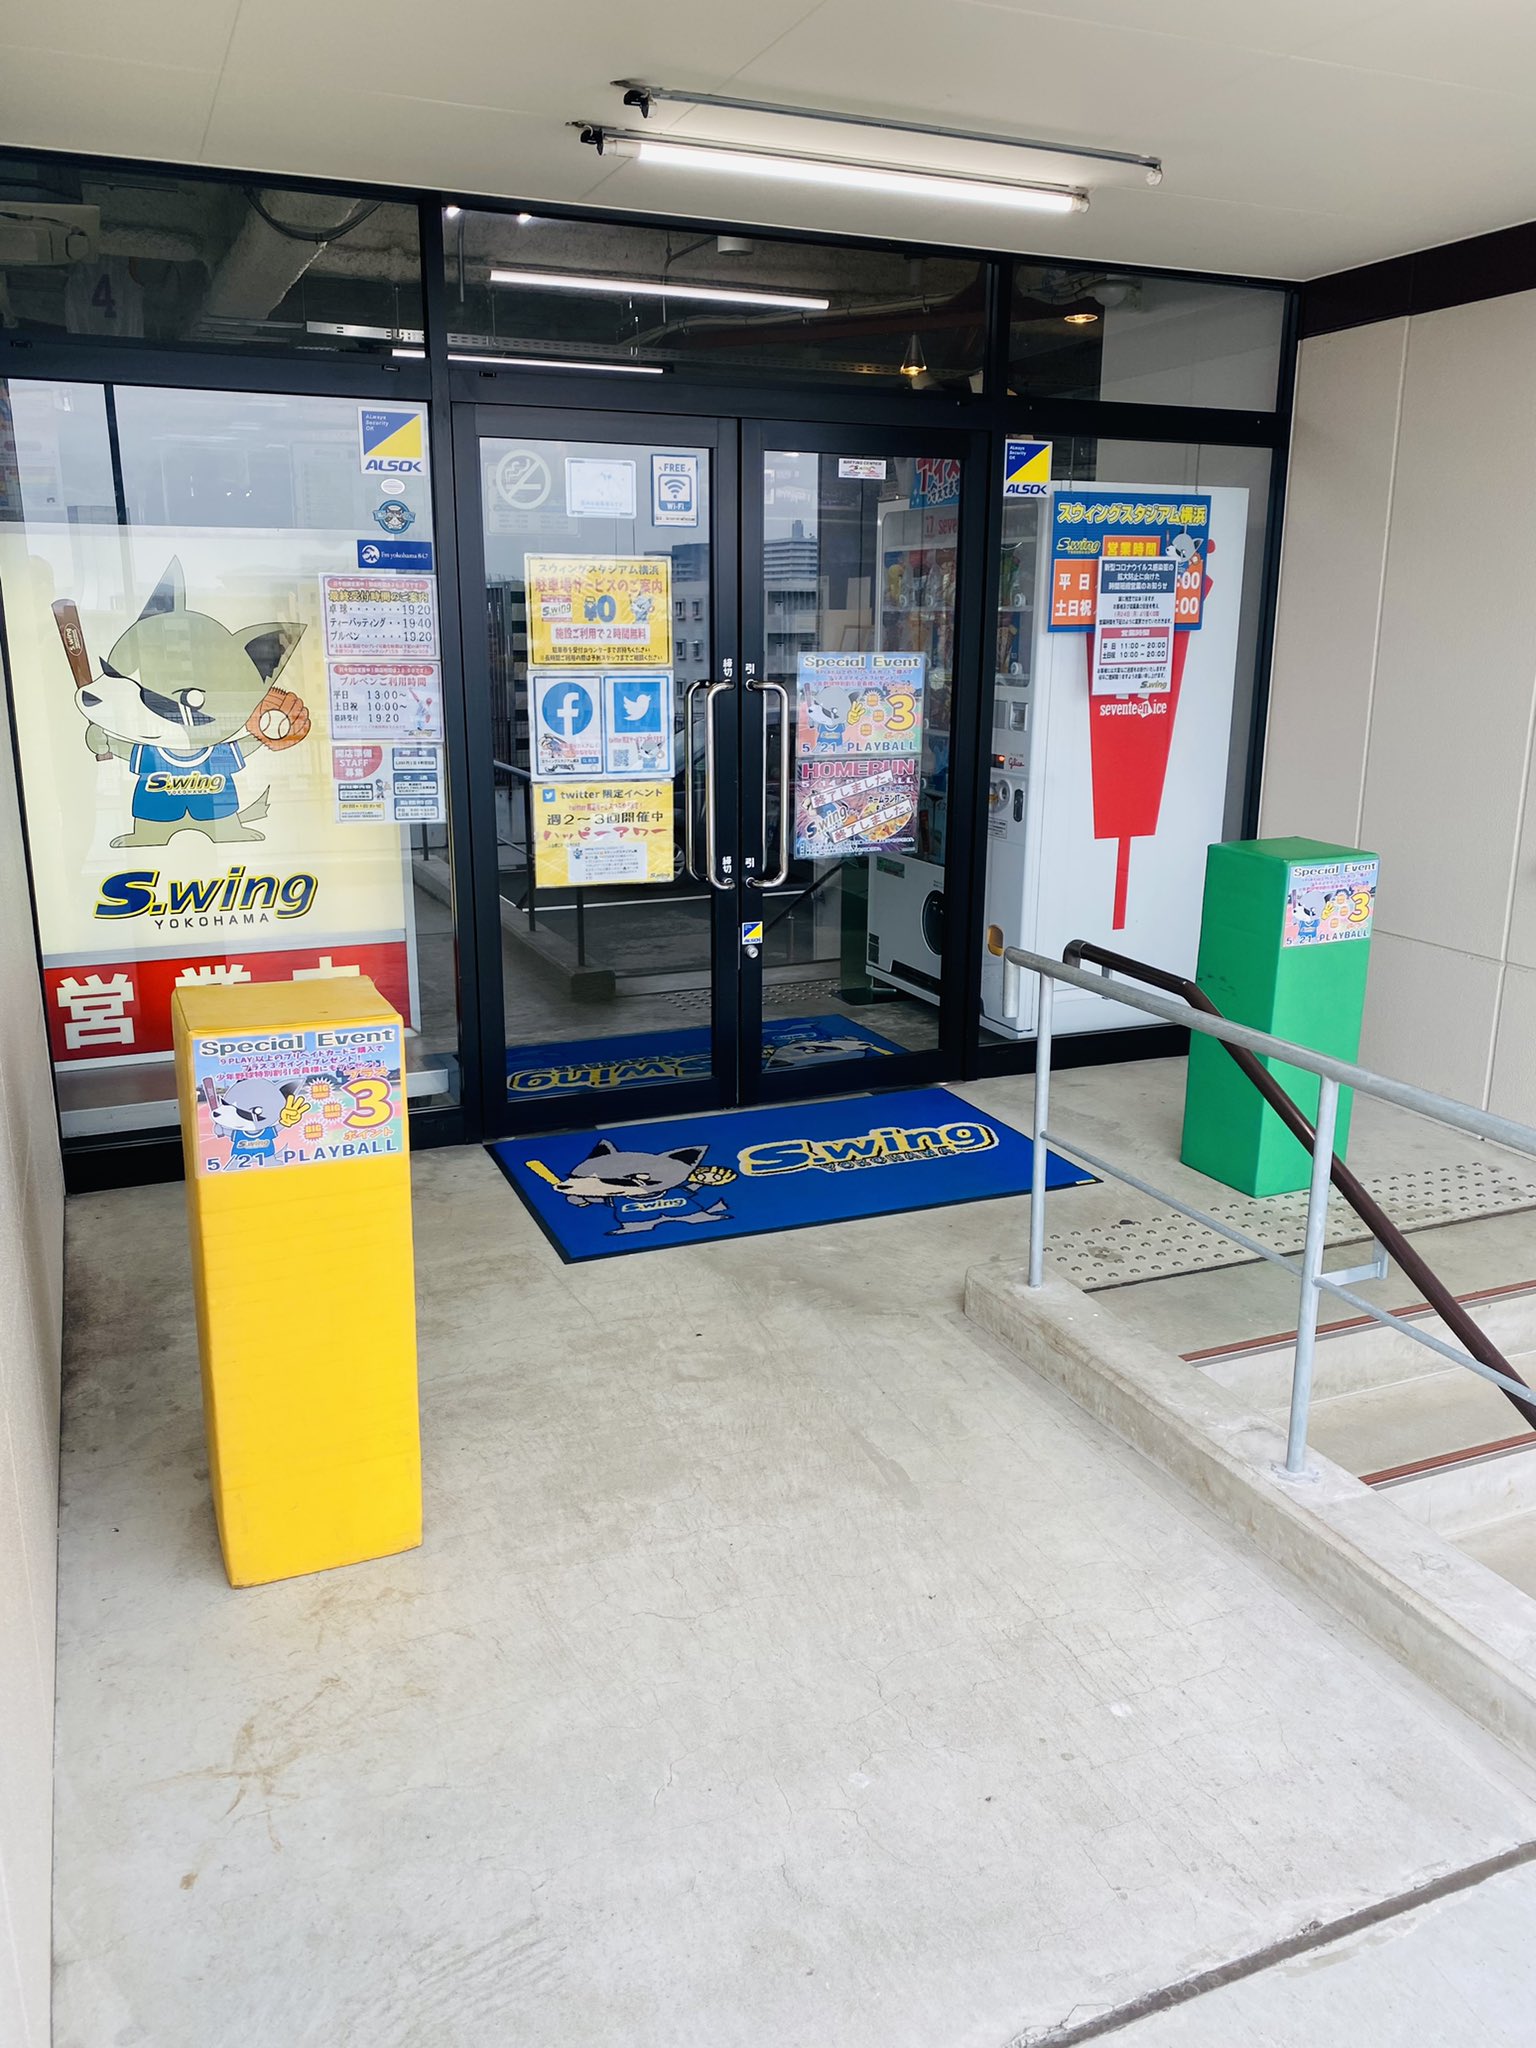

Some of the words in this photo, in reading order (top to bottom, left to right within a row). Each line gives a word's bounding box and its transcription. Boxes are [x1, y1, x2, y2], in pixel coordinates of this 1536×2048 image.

[365, 459, 422, 473] ALSOK
[663, 463, 686, 473] FREE
[1006, 484, 1047, 495] ALSOK
[1058, 503, 1206, 525] スウィングスタジアム横浜
[1055, 598, 1092, 617] 土日祝
[1146, 641, 1166, 649] 20:00
[804, 656, 865, 668] Special
[873, 656, 919, 667] Event
[1146, 650, 1166, 658] 20:00
[745, 663, 755, 675] 引
[884, 693, 916, 732] 3
[1100, 700, 1153, 718] seventeen
[1152, 699, 1168, 714] ice
[847, 741, 916, 752] PLAYBALL
[339, 759, 369, 768] STAFF
[801, 758, 915, 780] HOMERUN
[147, 771, 224, 792] S.wing
[560, 789, 600, 799] twitter
[602, 788, 663, 799] 限定イベント
[543, 826, 667, 841] ハッピーアワー
[745, 857, 755, 868] 引
[1294, 865, 1340, 877] Special
[1344, 862, 1376, 873] Event
[93, 866, 319, 920] S.wing
[1347, 891, 1370, 923] 3
[154, 913, 270, 930] YOKOHAMA
[1319, 929, 1368, 942] PLAYBALL
[201, 1034, 304, 1056] Special
[317, 1029, 393, 1047] Event
[341, 1077, 394, 1129] 3
[207, 1153, 265, 1172] 5/21
[283, 1139, 397, 1163] PLAYBALL
[740, 1123, 998, 1175] S.wing
[820, 1146, 957, 1172] YOKOHAMA
